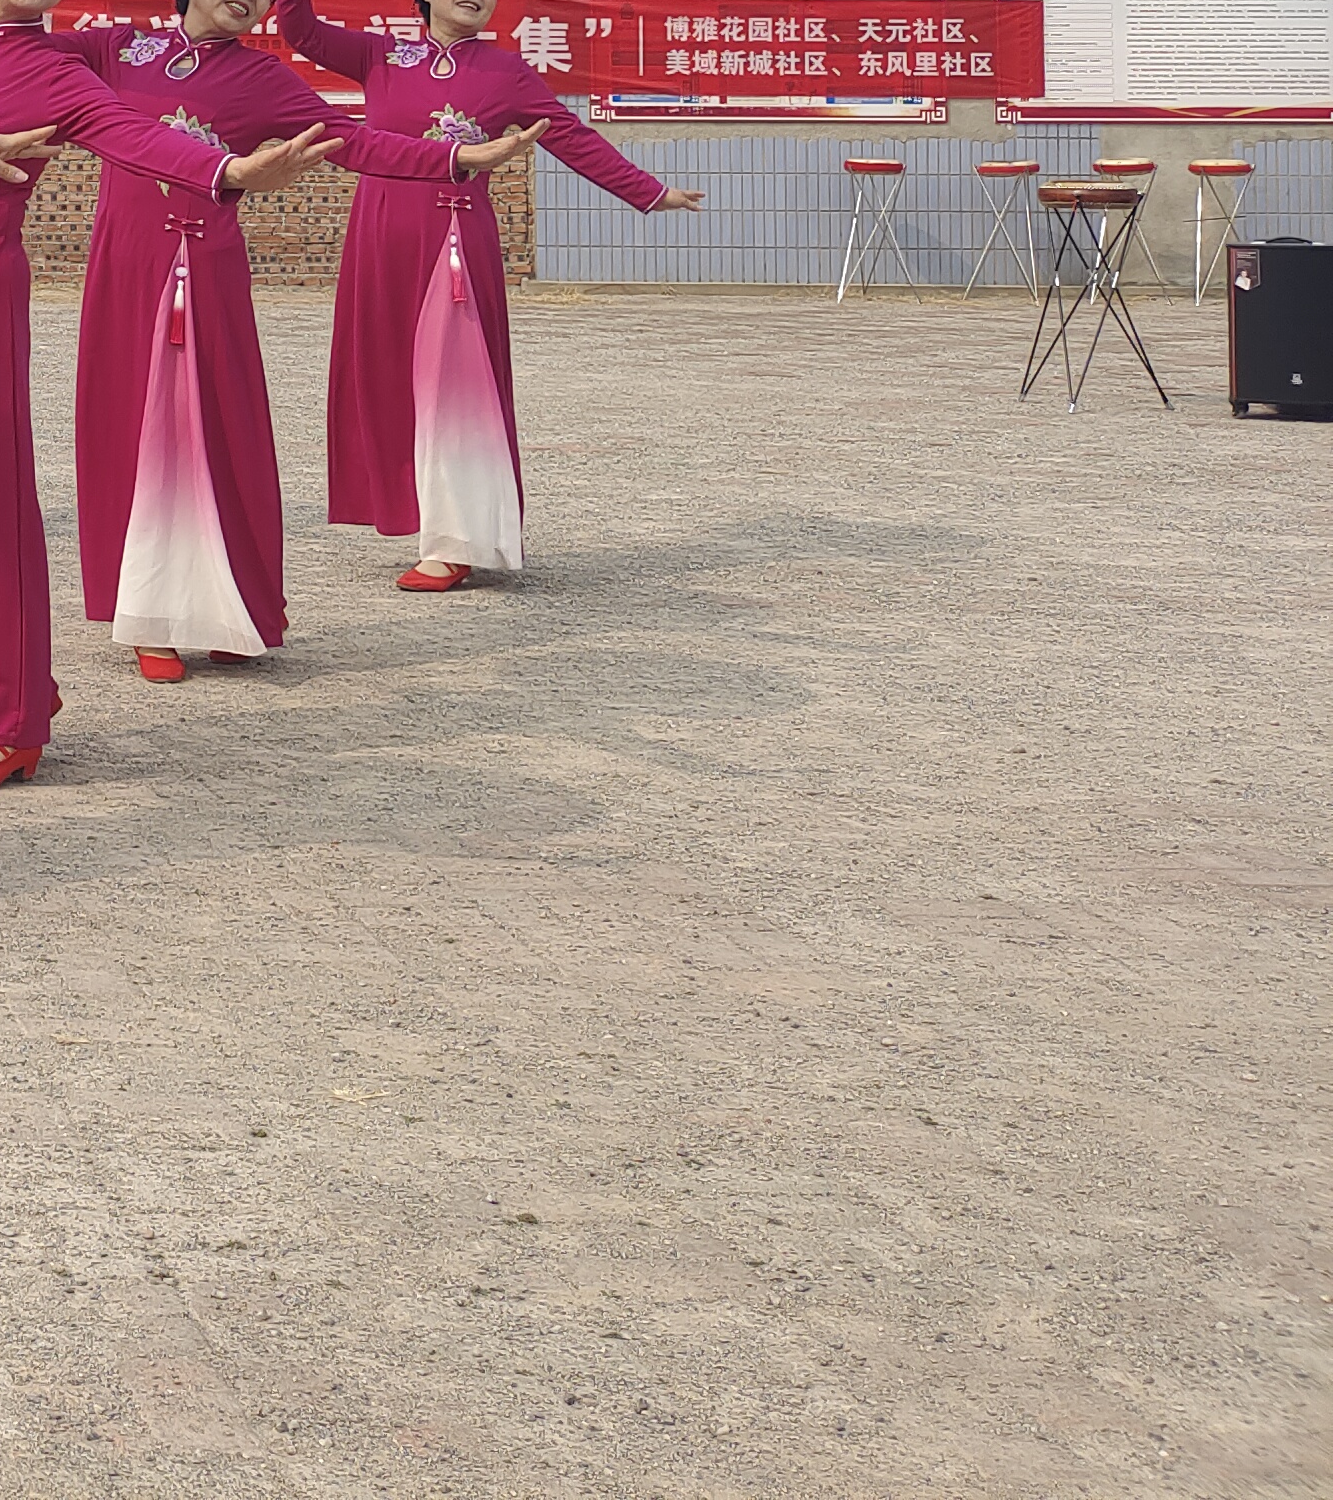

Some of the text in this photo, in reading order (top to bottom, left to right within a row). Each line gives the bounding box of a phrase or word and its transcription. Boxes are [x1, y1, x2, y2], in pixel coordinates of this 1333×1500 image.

[664, 16, 983, 43] 博雅花园社区、天元社区、
[664, 50, 995, 77] 美域新城社区、东风里社区
